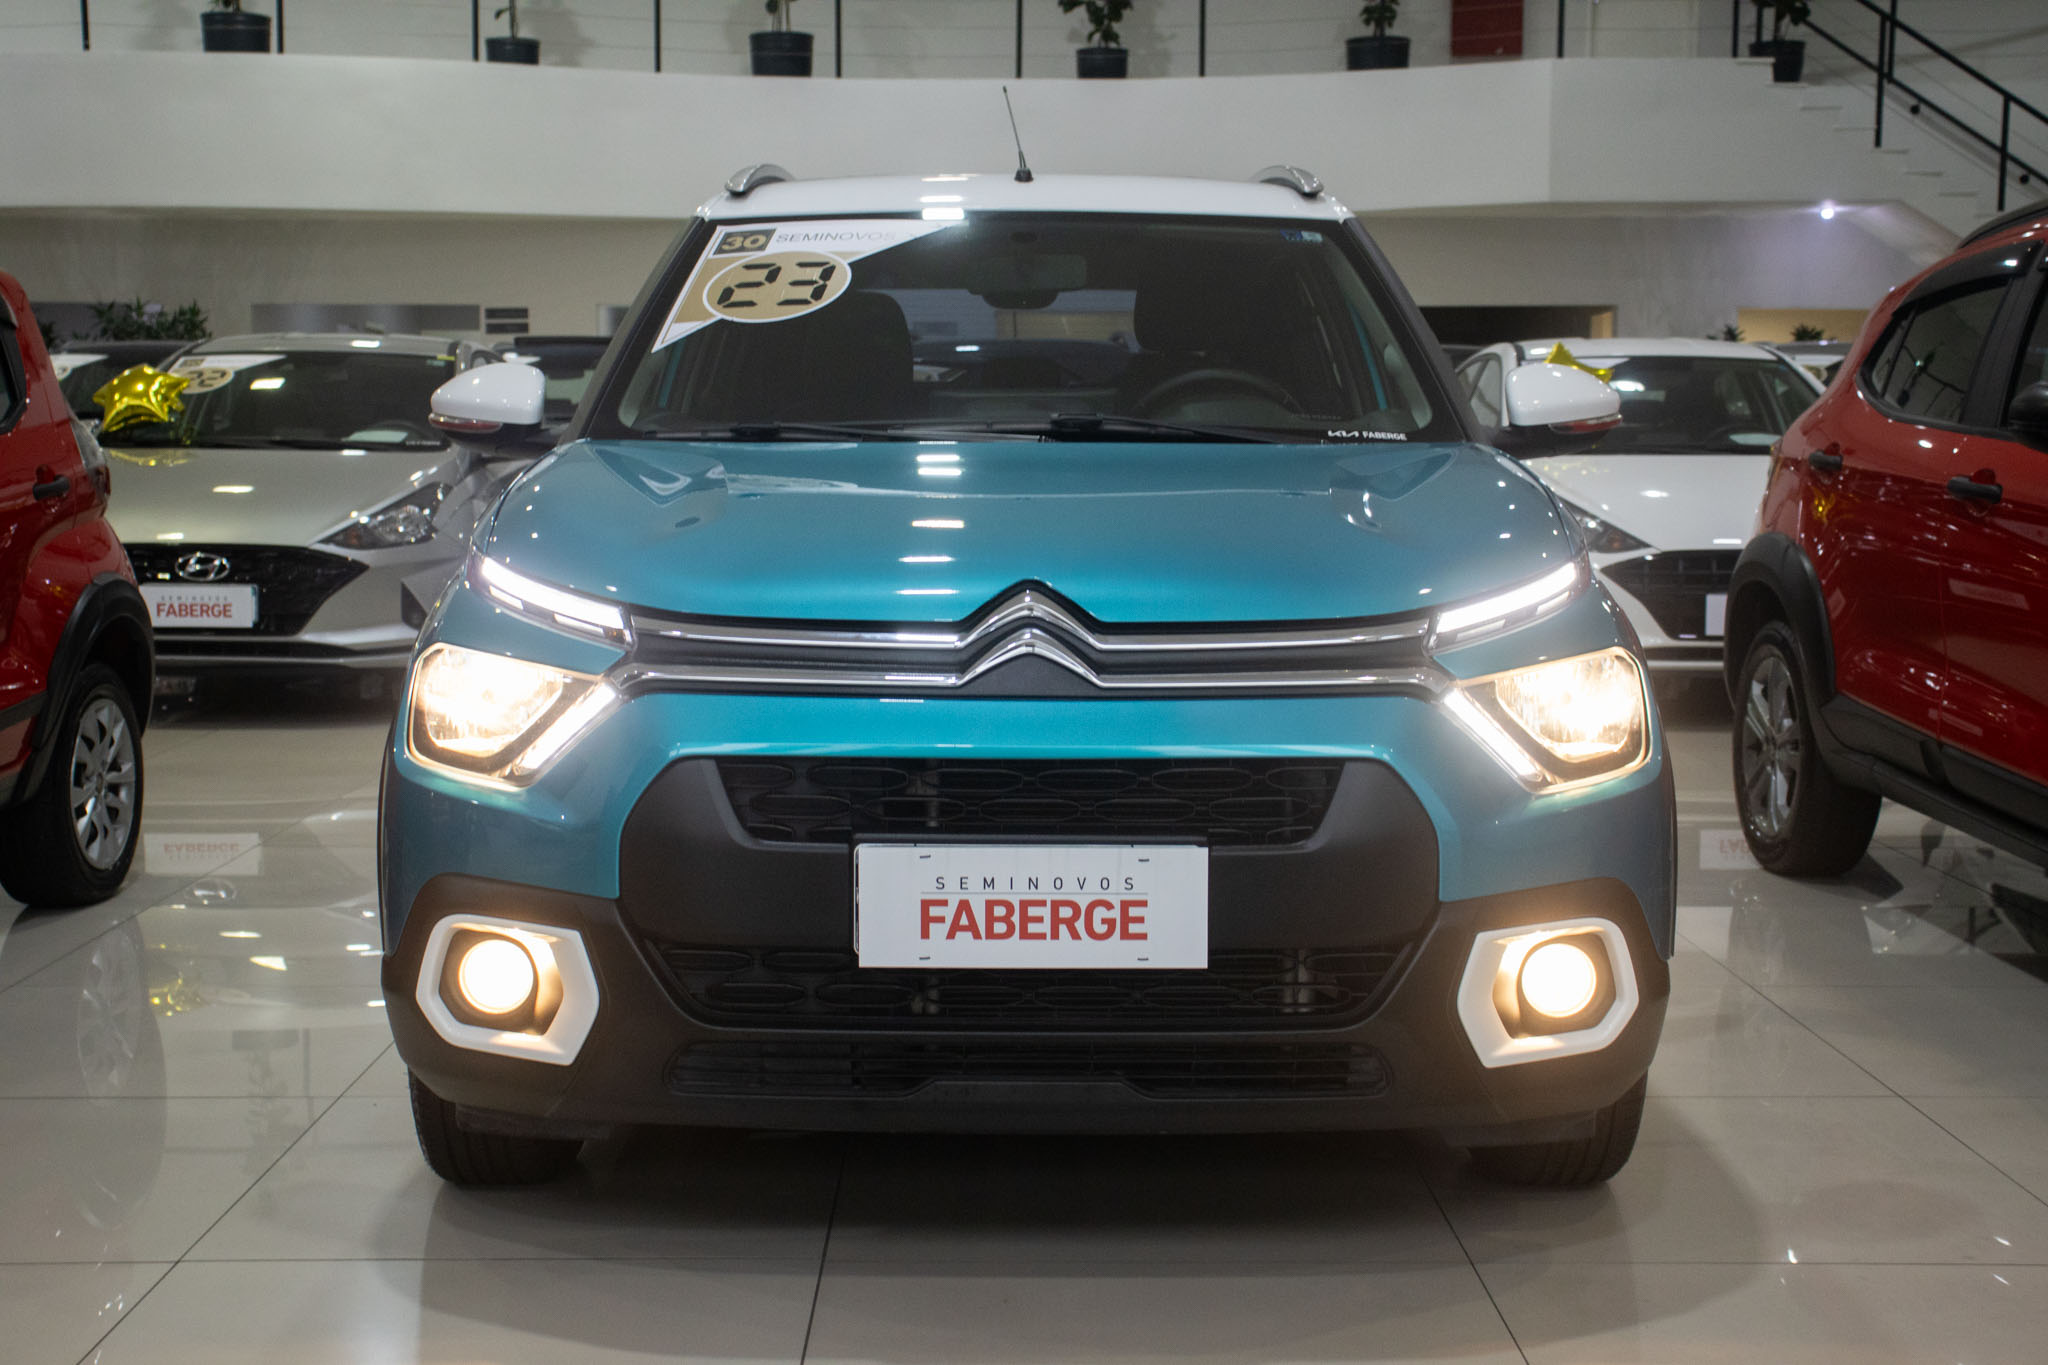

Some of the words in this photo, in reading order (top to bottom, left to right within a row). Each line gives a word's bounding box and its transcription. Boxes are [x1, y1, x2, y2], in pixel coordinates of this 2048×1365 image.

[721, 233, 768, 251] 30
[775, 230, 896, 243] SEMINOVOS
[716, 261, 837, 309] 23
[1362, 431, 1408, 441] FABERGE
[156, 602, 233, 618] FABERGE
[935, 876, 1135, 891] SEMINOVOS
[920, 898, 1149, 941] FABERGE
